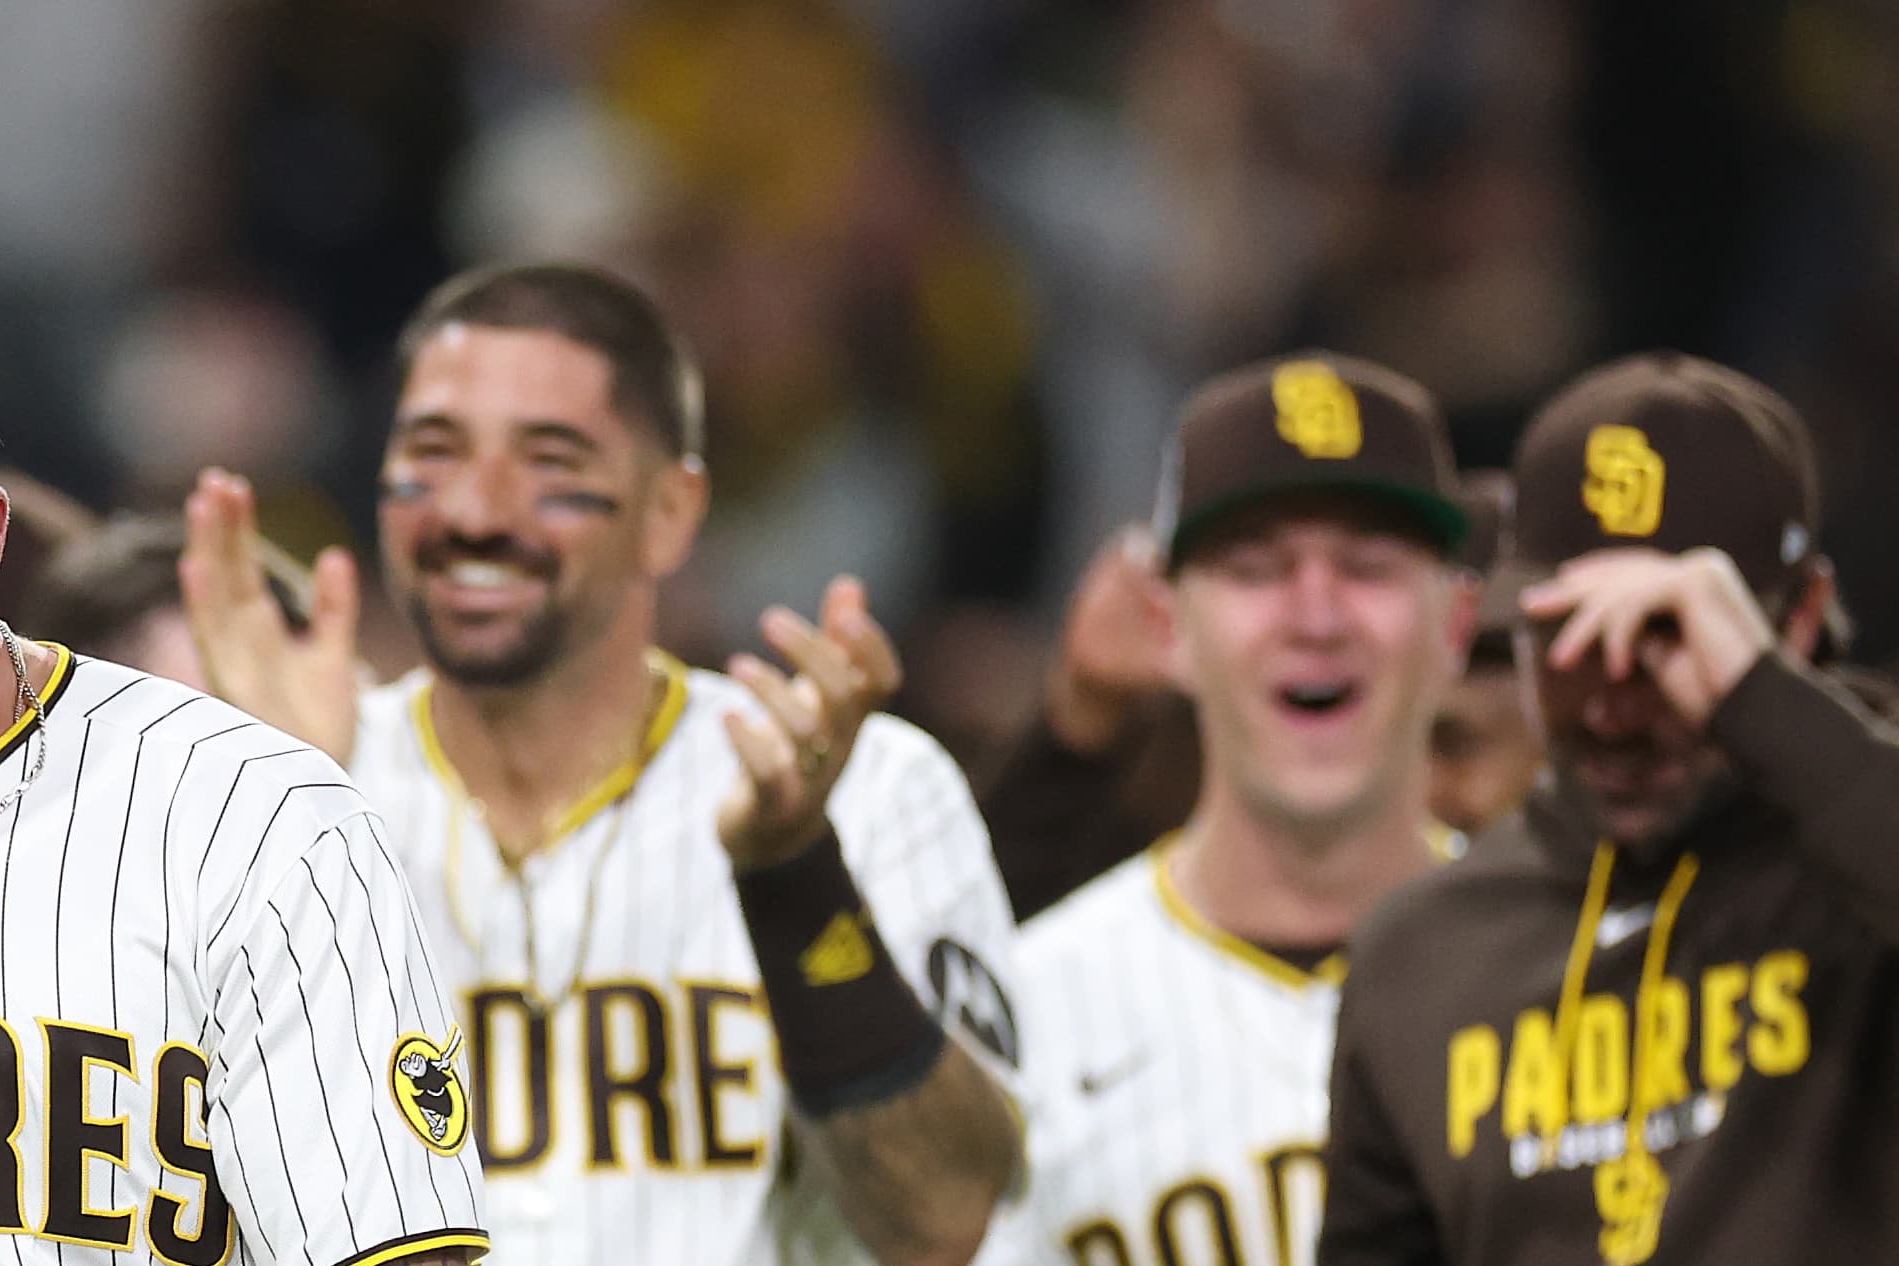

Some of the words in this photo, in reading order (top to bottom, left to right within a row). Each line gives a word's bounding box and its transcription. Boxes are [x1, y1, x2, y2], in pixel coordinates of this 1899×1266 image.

[1584, 425, 1666, 537] SD
[464, 976, 769, 1174] DRE
[1447, 950, 1812, 1158] PADRES
